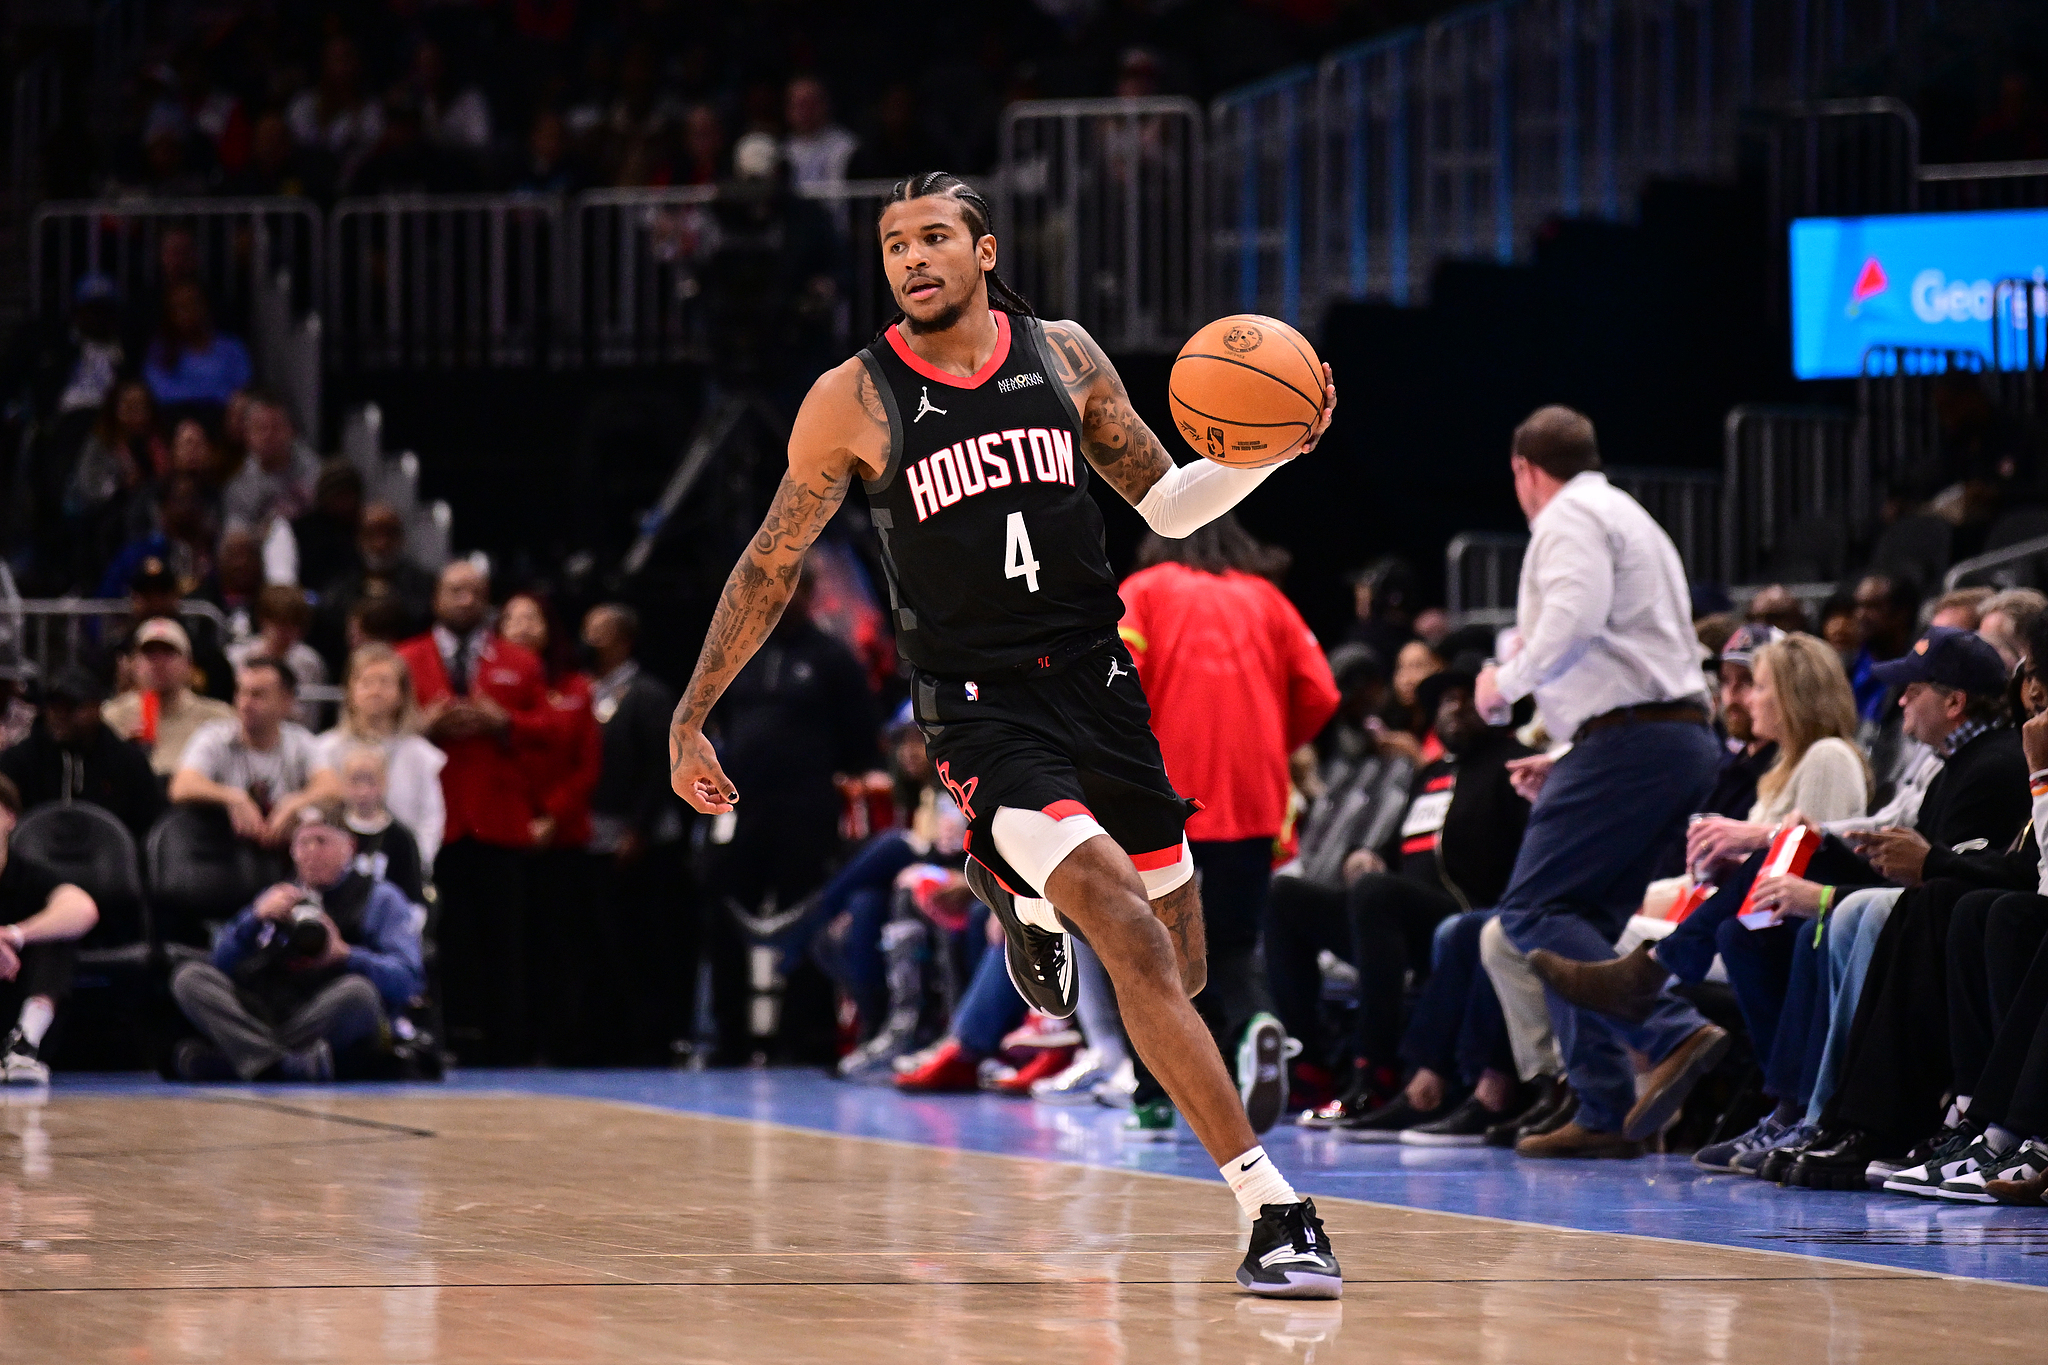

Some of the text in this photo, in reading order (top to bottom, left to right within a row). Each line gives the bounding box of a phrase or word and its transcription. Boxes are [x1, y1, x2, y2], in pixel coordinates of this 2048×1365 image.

[997, 372, 1043, 388] MEMORIAL
[999, 376, 1044, 394] HERMANN
[905, 428, 1076, 523] HOUSTON
[1004, 511, 1041, 593] 4
